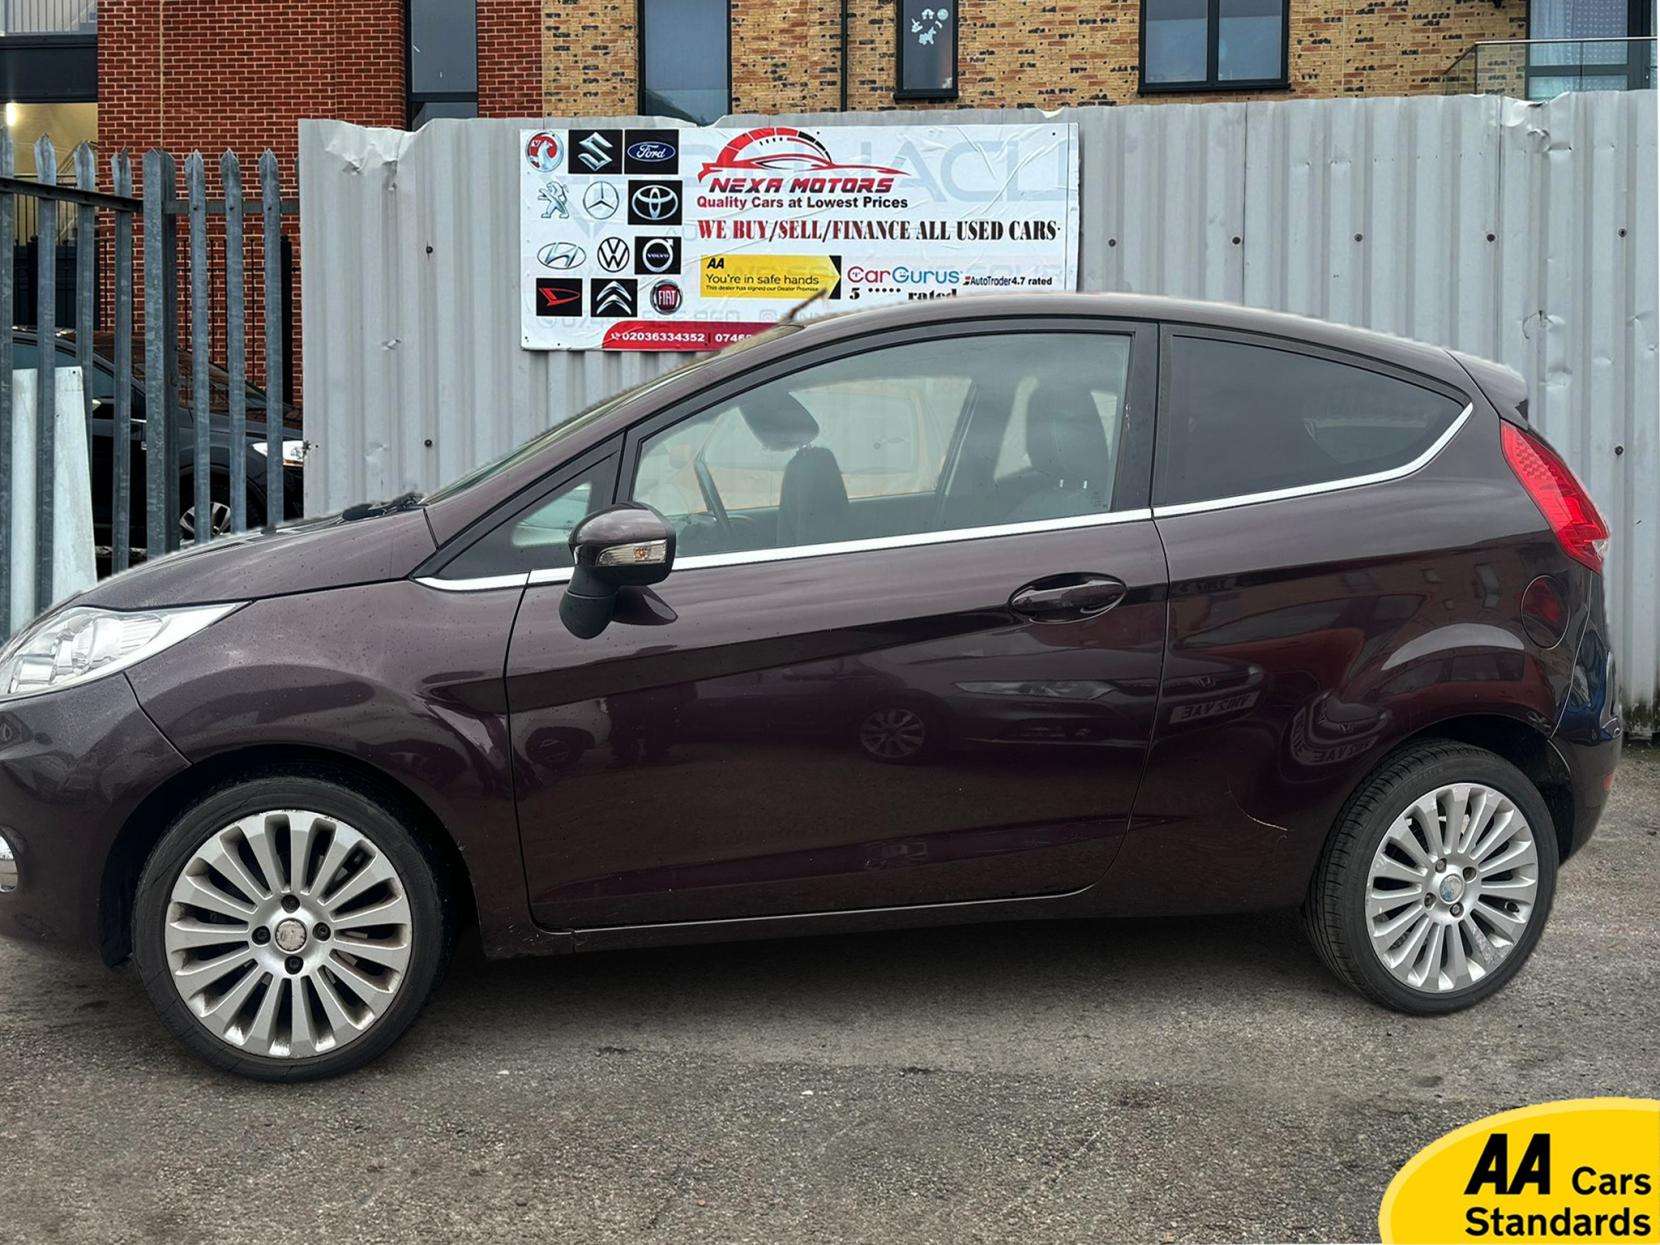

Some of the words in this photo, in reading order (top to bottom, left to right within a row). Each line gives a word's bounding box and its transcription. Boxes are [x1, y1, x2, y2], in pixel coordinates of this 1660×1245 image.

[636, 144, 666, 159] Ford
[708, 178, 781, 194] NEXA
[788, 178, 895, 194] MOTORS
[697, 195, 748, 210] Quality
[751, 195, 784, 209] Cars
[788, 196, 803, 209] at
[807, 195, 858, 209] Lowest
[862, 195, 909, 209] Prices
[698, 220, 727, 240] WE
[915, 220, 950, 240] ALL
[956, 220, 1004, 240] USED
[706, 257, 725, 269] AA
[706, 274, 741, 284] You're
[745, 274, 754, 284] in
[757, 274, 781, 285] safe
[784, 275, 820, 285] hands
[847, 266, 960, 284] CarGurus
[1028, 276, 1053, 285] rated
[657, 290, 676, 305] FIAT
[849, 287, 861, 300] 5
[622, 332, 705, 342] 02036334352
